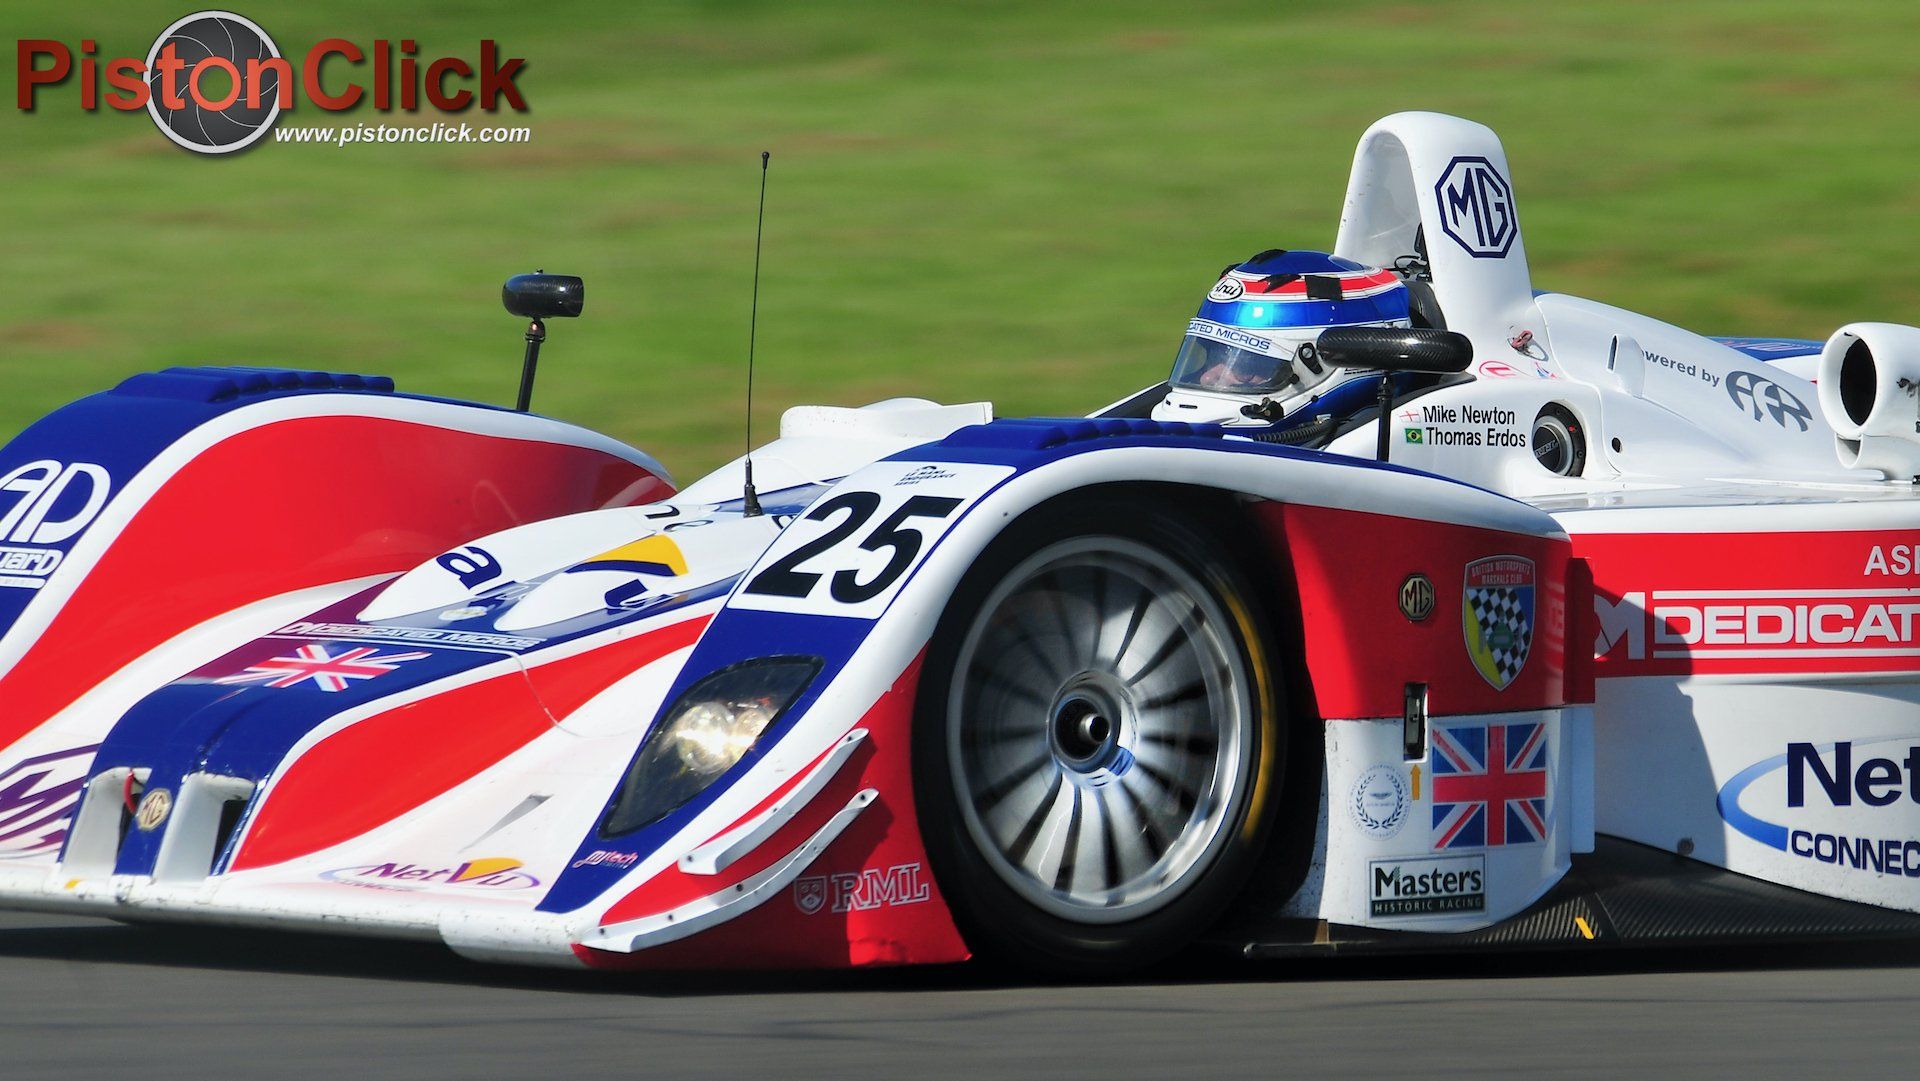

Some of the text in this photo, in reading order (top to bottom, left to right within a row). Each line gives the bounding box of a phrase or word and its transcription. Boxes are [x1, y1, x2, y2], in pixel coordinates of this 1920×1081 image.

[1445, 166, 1510, 248] MG
[1216, 328, 1271, 350] MICROS
[1641, 350, 1720, 387] wered by
[1423, 406, 1515, 425] Mike Newton
[1426, 428, 1526, 447] Thomas Erdos
[742, 491, 965, 604] 25
[1401, 576, 1433, 615] MG
[442, 633, 542, 648] MICROS
[1787, 742, 1920, 807] Net
[1791, 830, 1920, 878] CONNEC
[832, 863, 929, 912] RML
[1375, 865, 1482, 897] Masters
[1374, 897, 1481, 913] HISTORIC RACING
